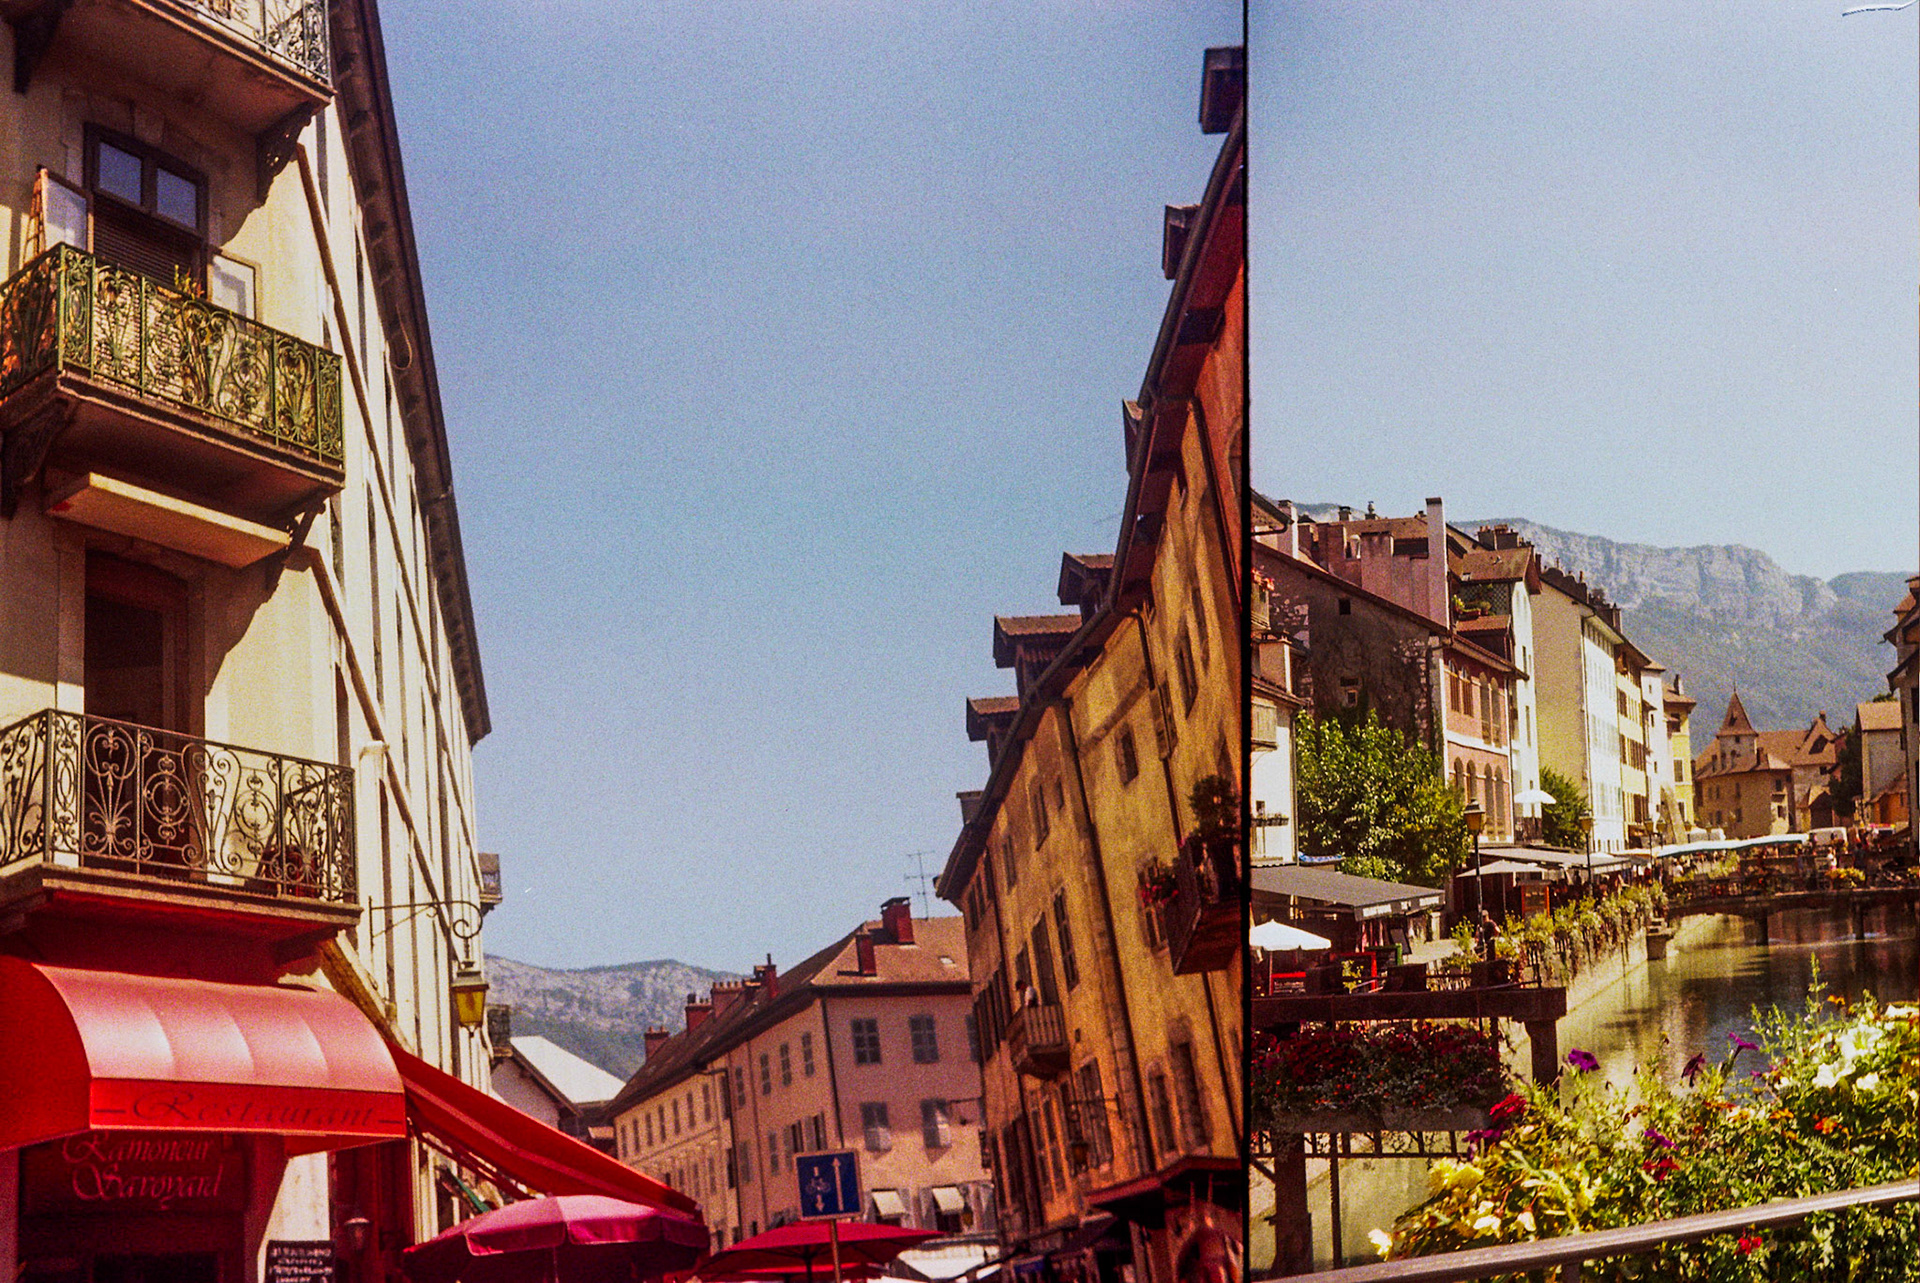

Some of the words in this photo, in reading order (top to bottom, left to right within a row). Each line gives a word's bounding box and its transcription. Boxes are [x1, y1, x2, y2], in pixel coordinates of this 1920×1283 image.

[134, 1091, 374, 1126] Restaurant
[62, 1134, 213, 1163] Ramoneur
[73, 1164, 223, 1209] Savoyard
